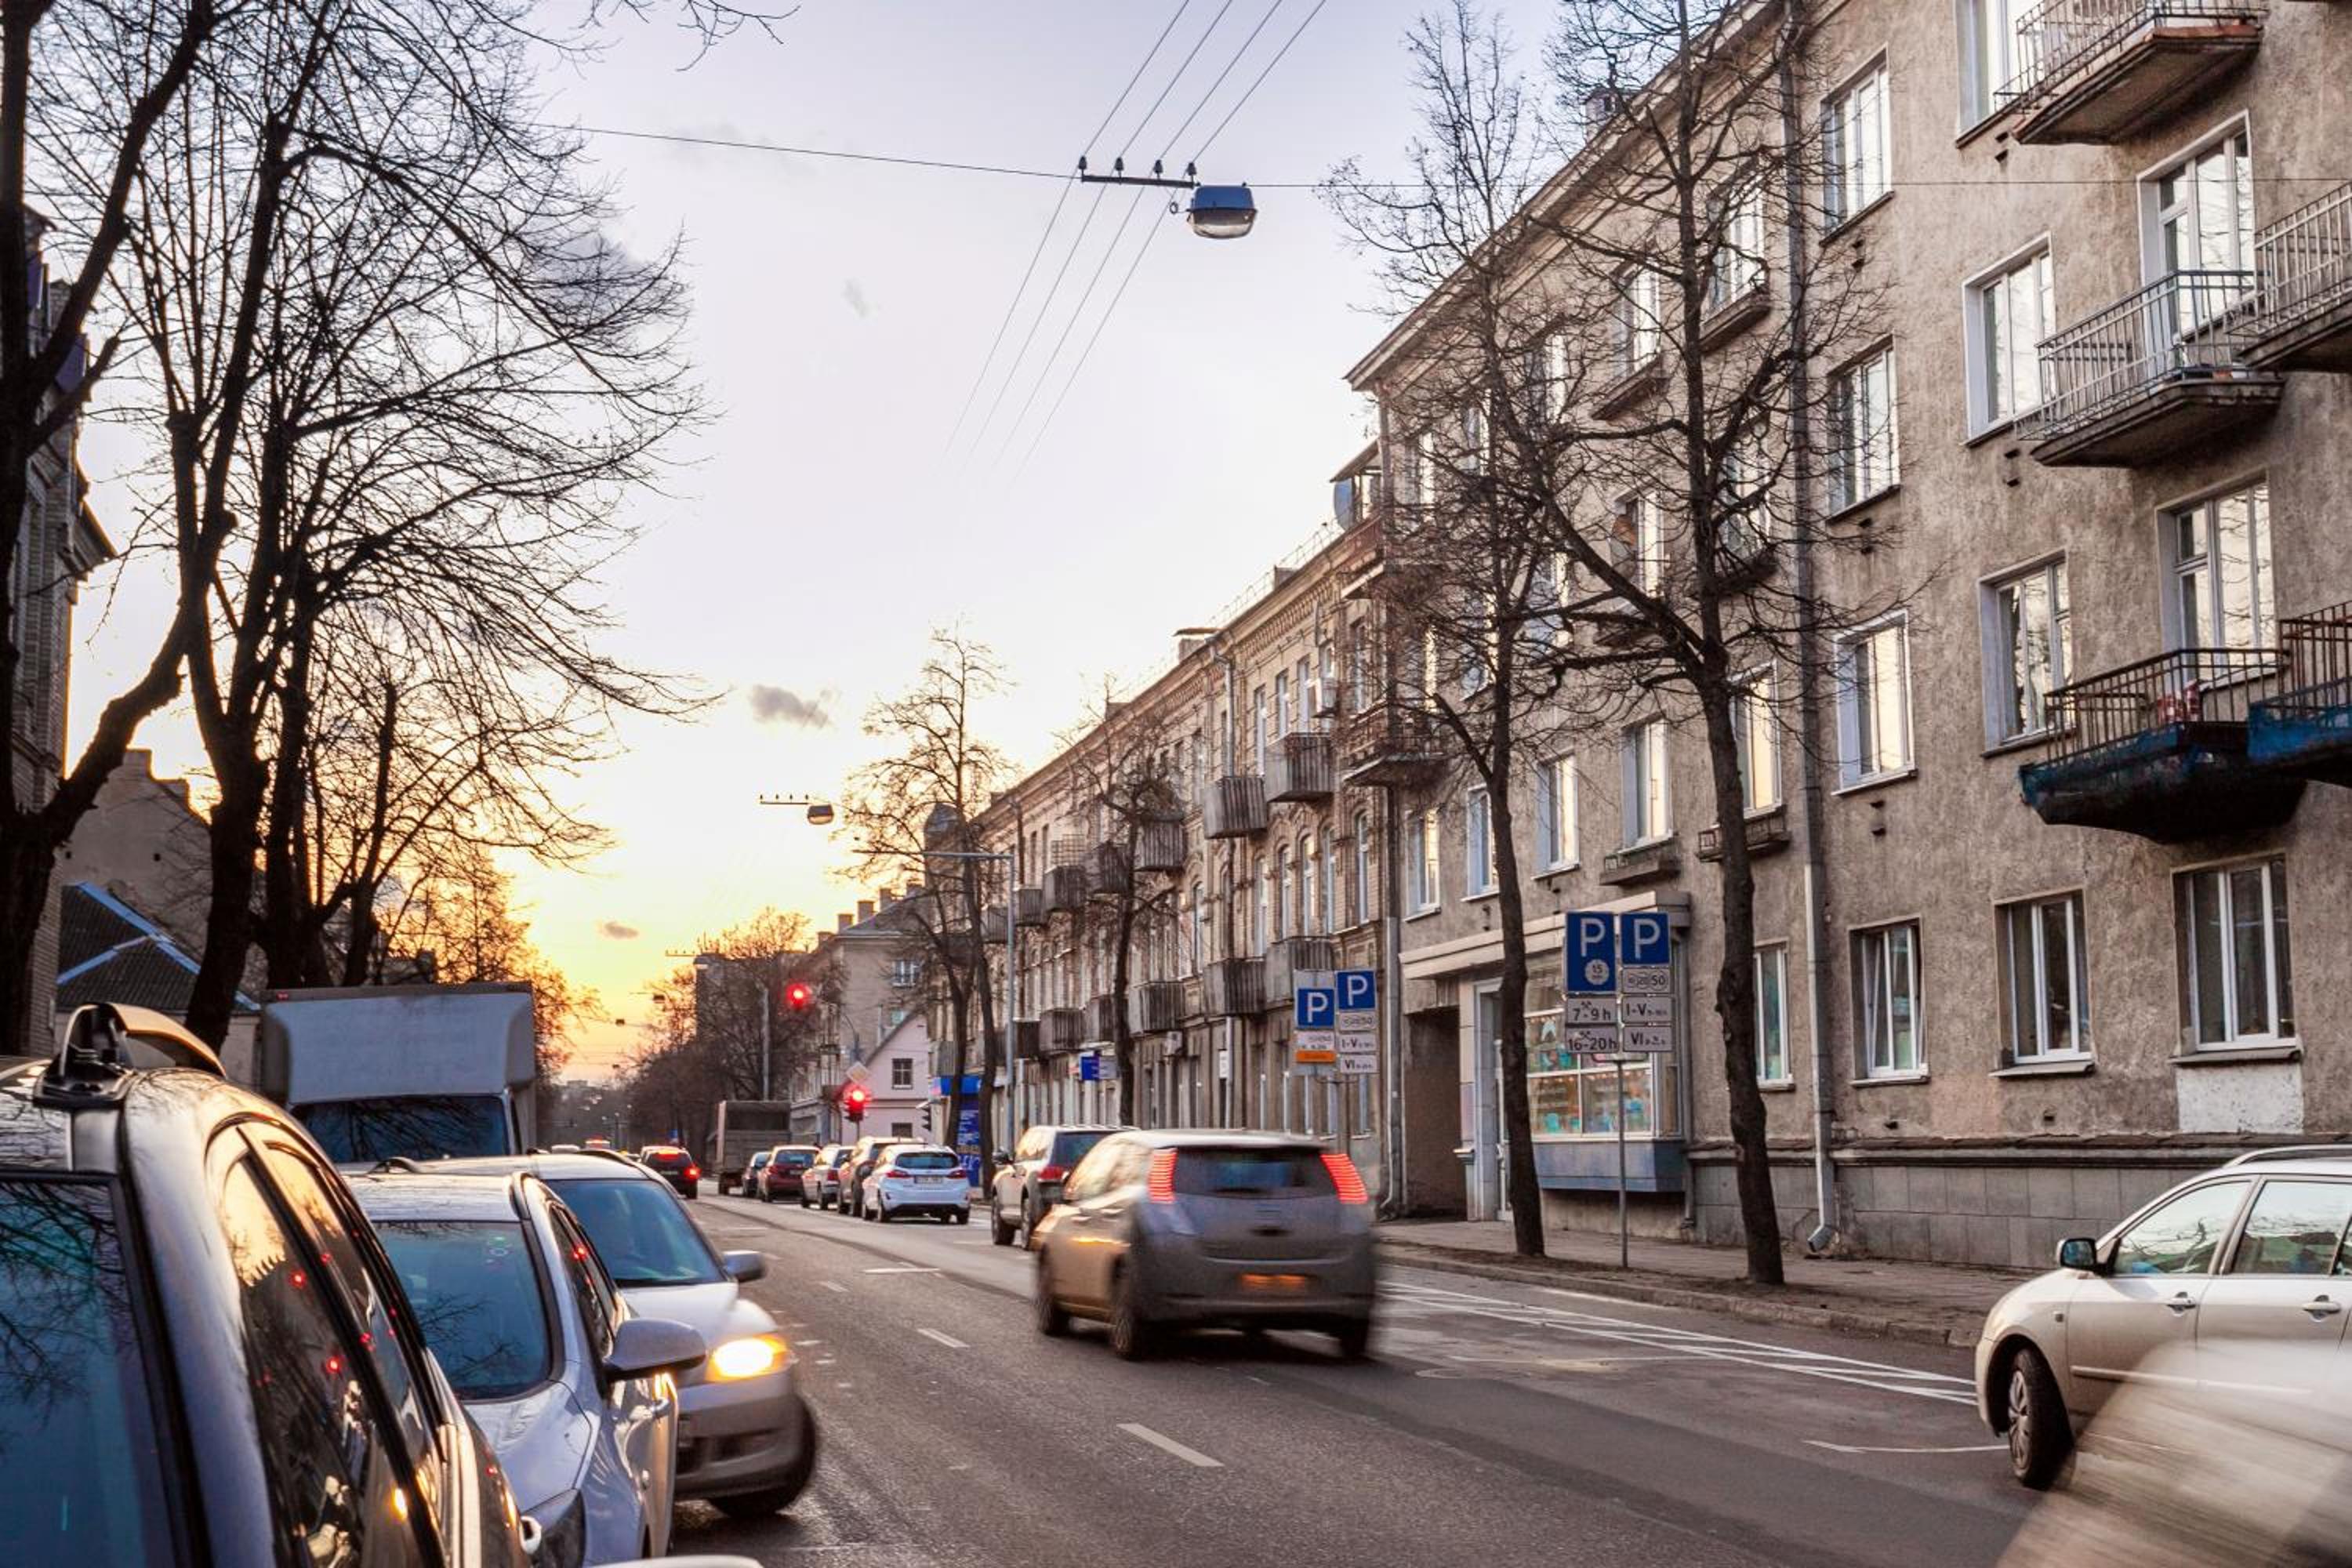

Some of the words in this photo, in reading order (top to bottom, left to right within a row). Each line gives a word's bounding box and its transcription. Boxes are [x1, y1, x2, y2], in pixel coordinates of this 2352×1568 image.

[1580, 917, 1606, 958] P
[1633, 918, 1661, 960] P
[1347, 975, 1368, 1006] P
[1651, 974, 1666, 986] 50
[1307, 992, 1329, 1023] P
